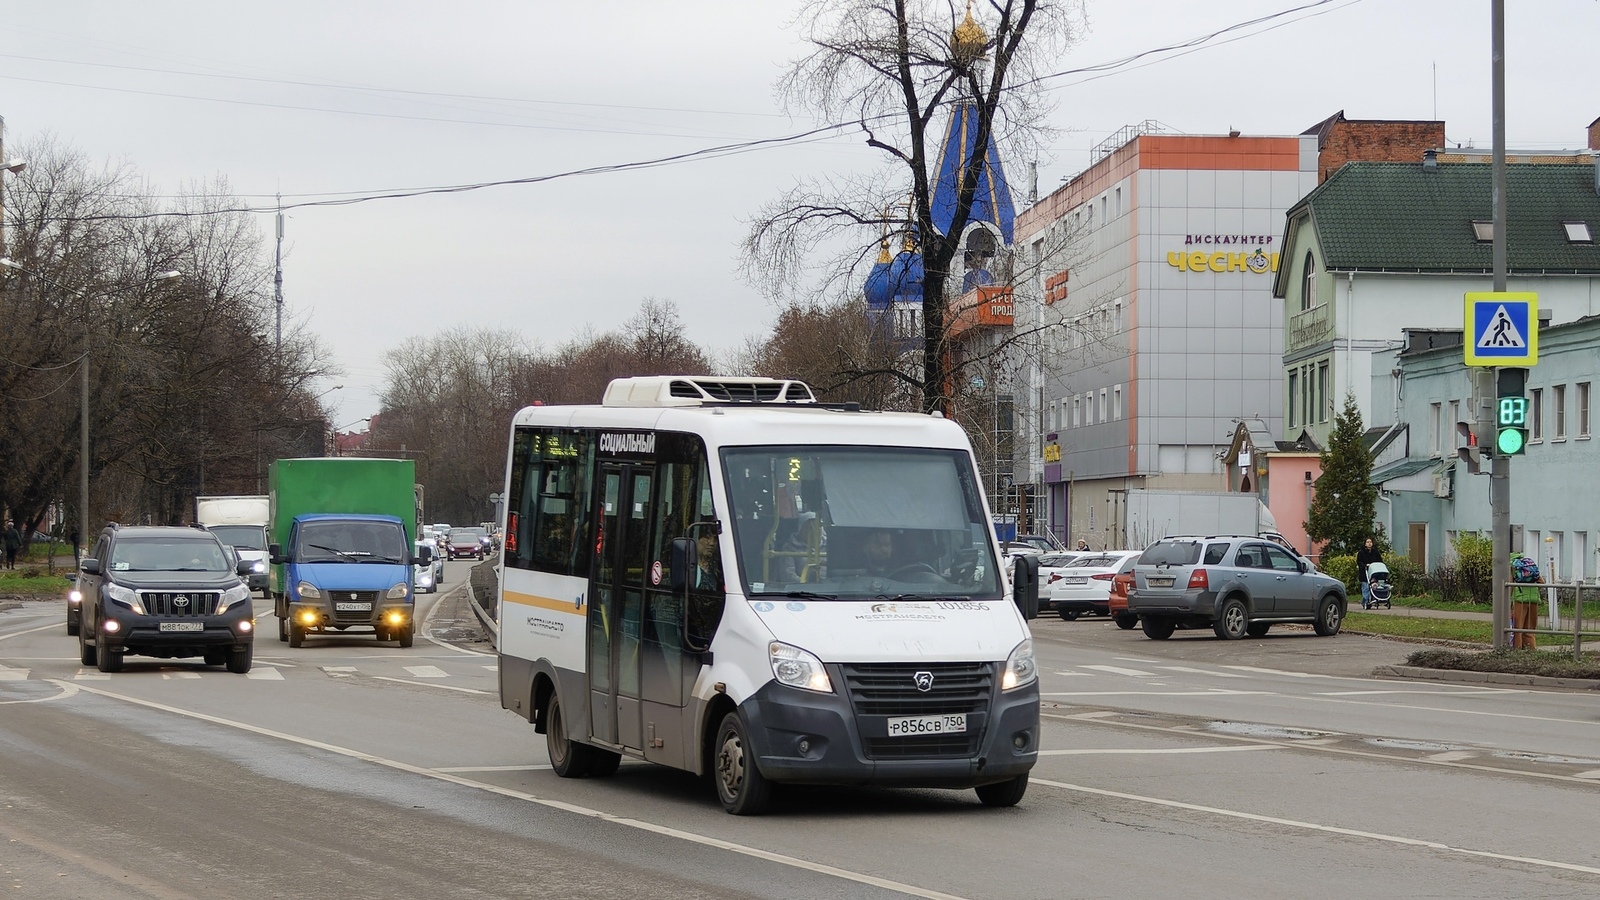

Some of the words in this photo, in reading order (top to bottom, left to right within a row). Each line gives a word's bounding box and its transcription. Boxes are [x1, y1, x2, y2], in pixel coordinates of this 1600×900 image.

[1185, 234, 1273, 245] ДИСКАУНТЕР
[992, 305, 1014, 317] ПРОД
[1500, 398, 1525, 424] 83
[600, 432, 656, 456] СОЦИАЛЬНЫЙ
[936, 602, 990, 612] 101856
[892, 719, 942, 734] Р856СВ
[944, 716, 963, 728] 750
